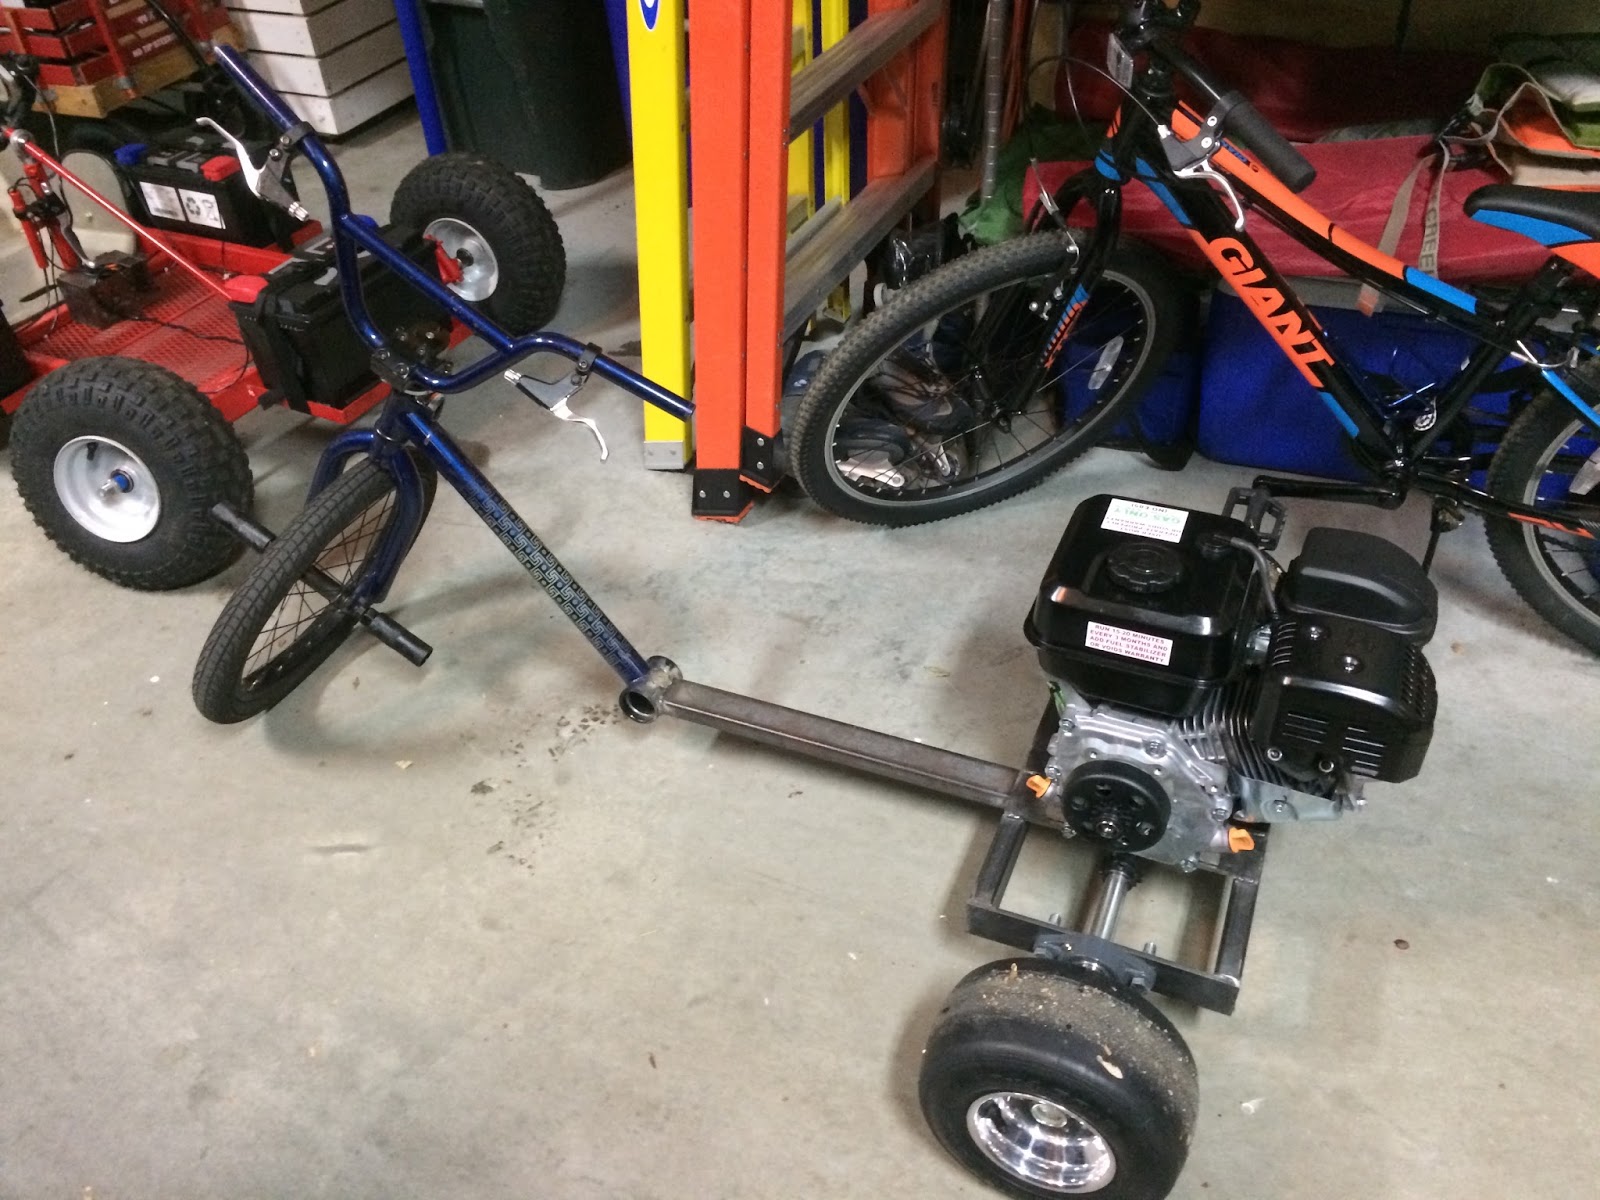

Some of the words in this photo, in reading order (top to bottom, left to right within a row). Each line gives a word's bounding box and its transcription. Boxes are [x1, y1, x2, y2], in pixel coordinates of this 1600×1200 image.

[1207, 237, 1335, 366] GIANT
[1114, 508, 1148, 518] ONLY
[1154, 515, 1180, 524] GAS
[1121, 636, 1150, 647] MONTHS
[1132, 633, 1164, 644] MINUTES
[1125, 650, 1164, 662] WARRANTY
[1126, 644, 1166, 657] STABILIZER
